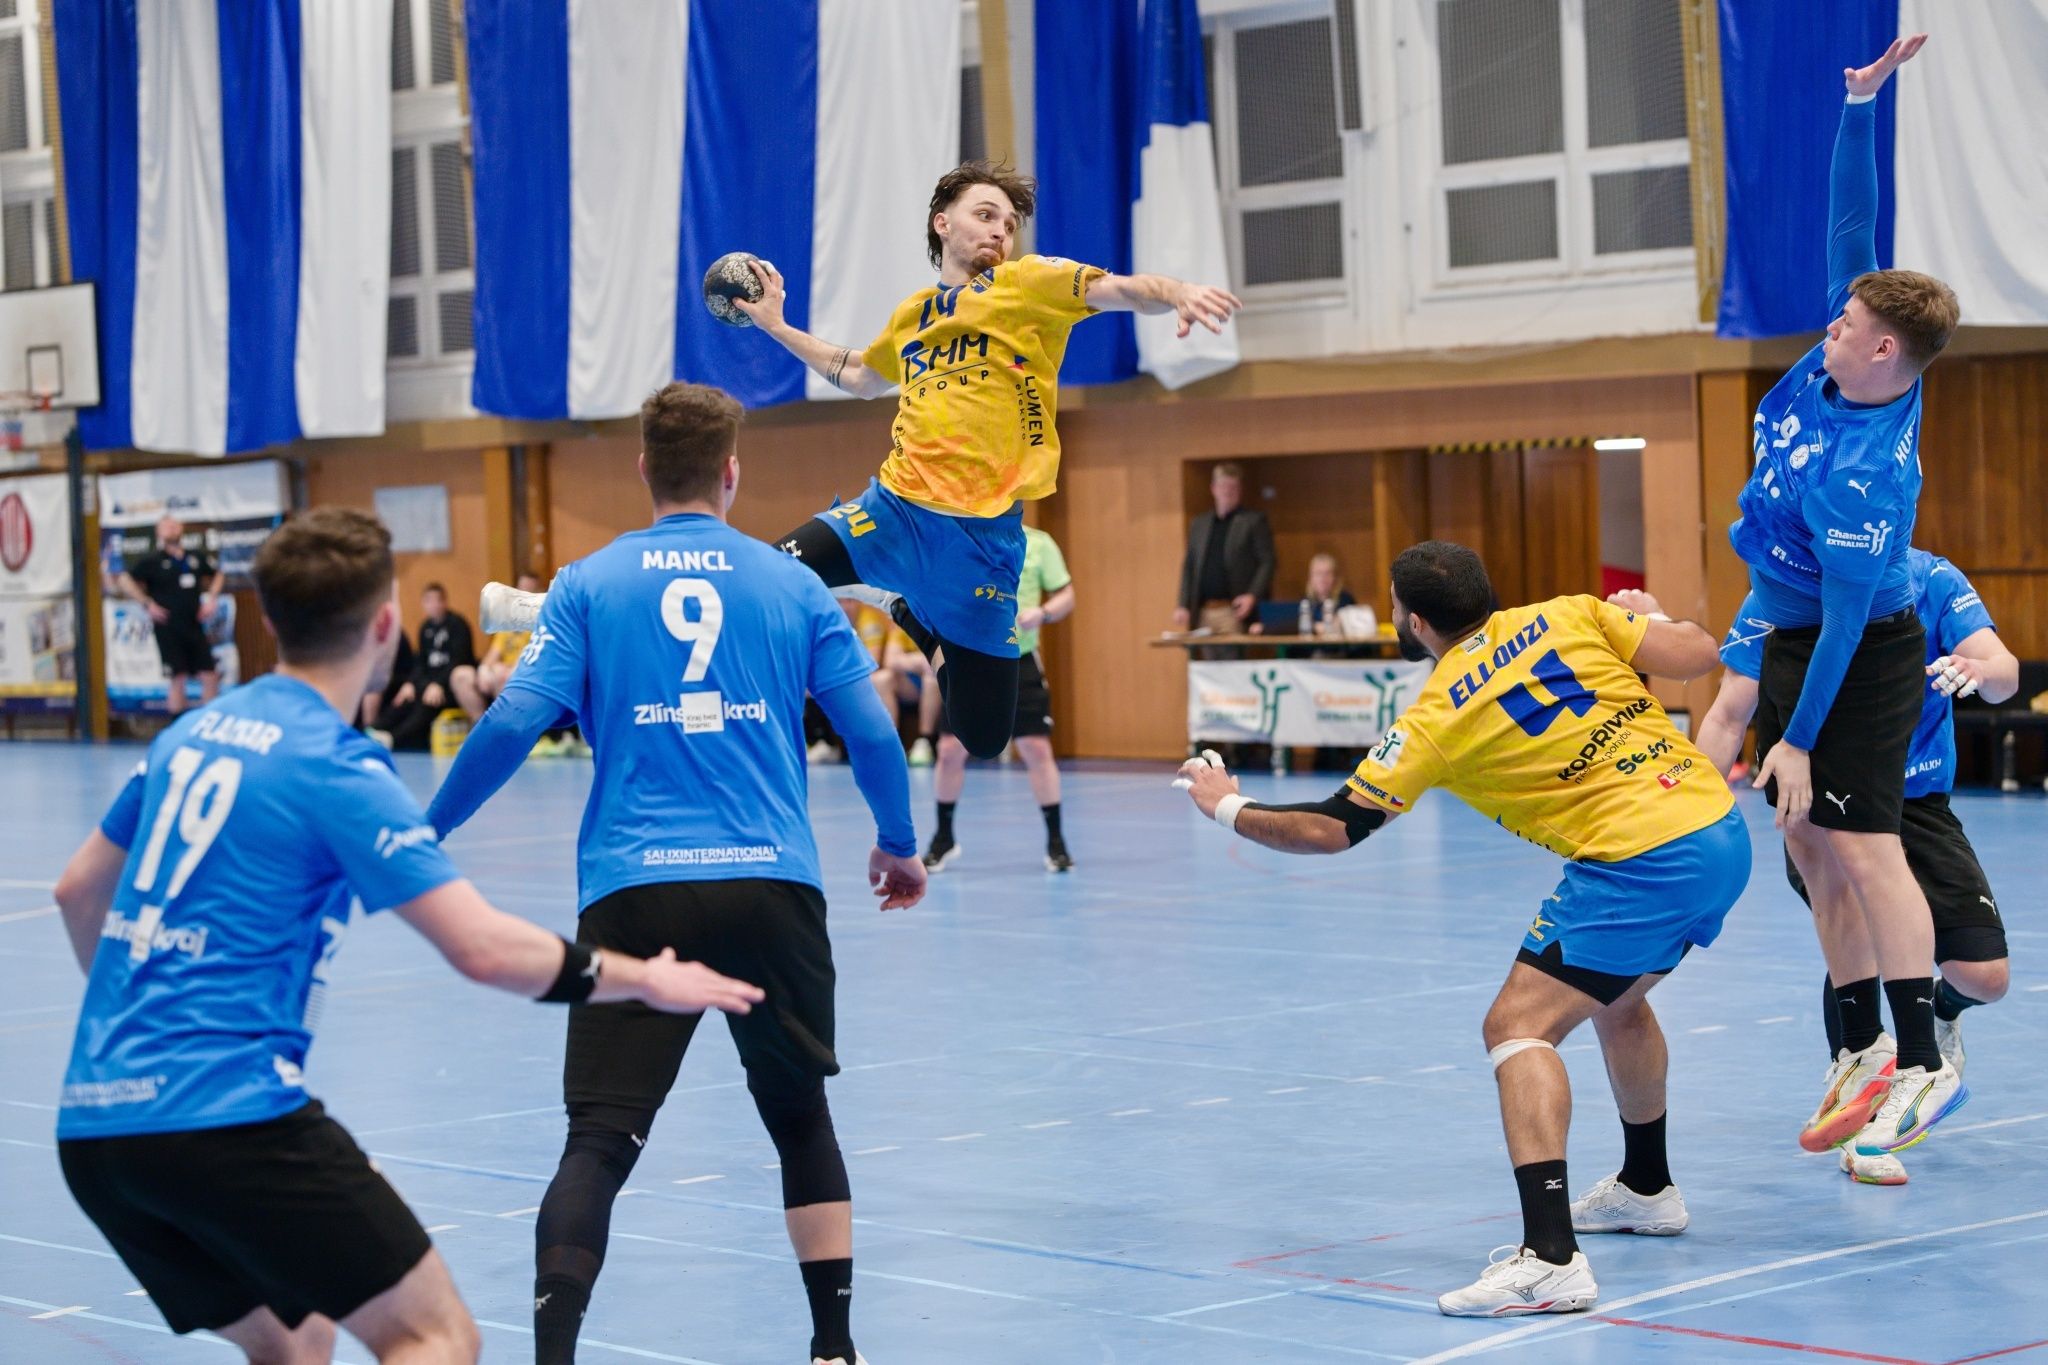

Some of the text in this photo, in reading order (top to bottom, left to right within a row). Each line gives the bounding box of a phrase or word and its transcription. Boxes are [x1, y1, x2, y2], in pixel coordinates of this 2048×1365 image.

[905, 370, 989, 407] GROUP
[1016, 383, 1026, 441] elektro
[1025, 375, 1044, 447] LUMEN
[828, 503, 878, 538] 24
[1827, 528, 1871, 541] Chance
[642, 550, 733, 571] MANCL
[1826, 538, 1870, 549] EXTRALIGA
[660, 577, 723, 682] 9
[1448, 613, 1549, 710] ELLOUZI
[1496, 648, 1598, 737] 4
[723, 699, 767, 724] kraj
[1604, 729, 1632, 760] pohybu
[133, 746, 244, 899] 19
